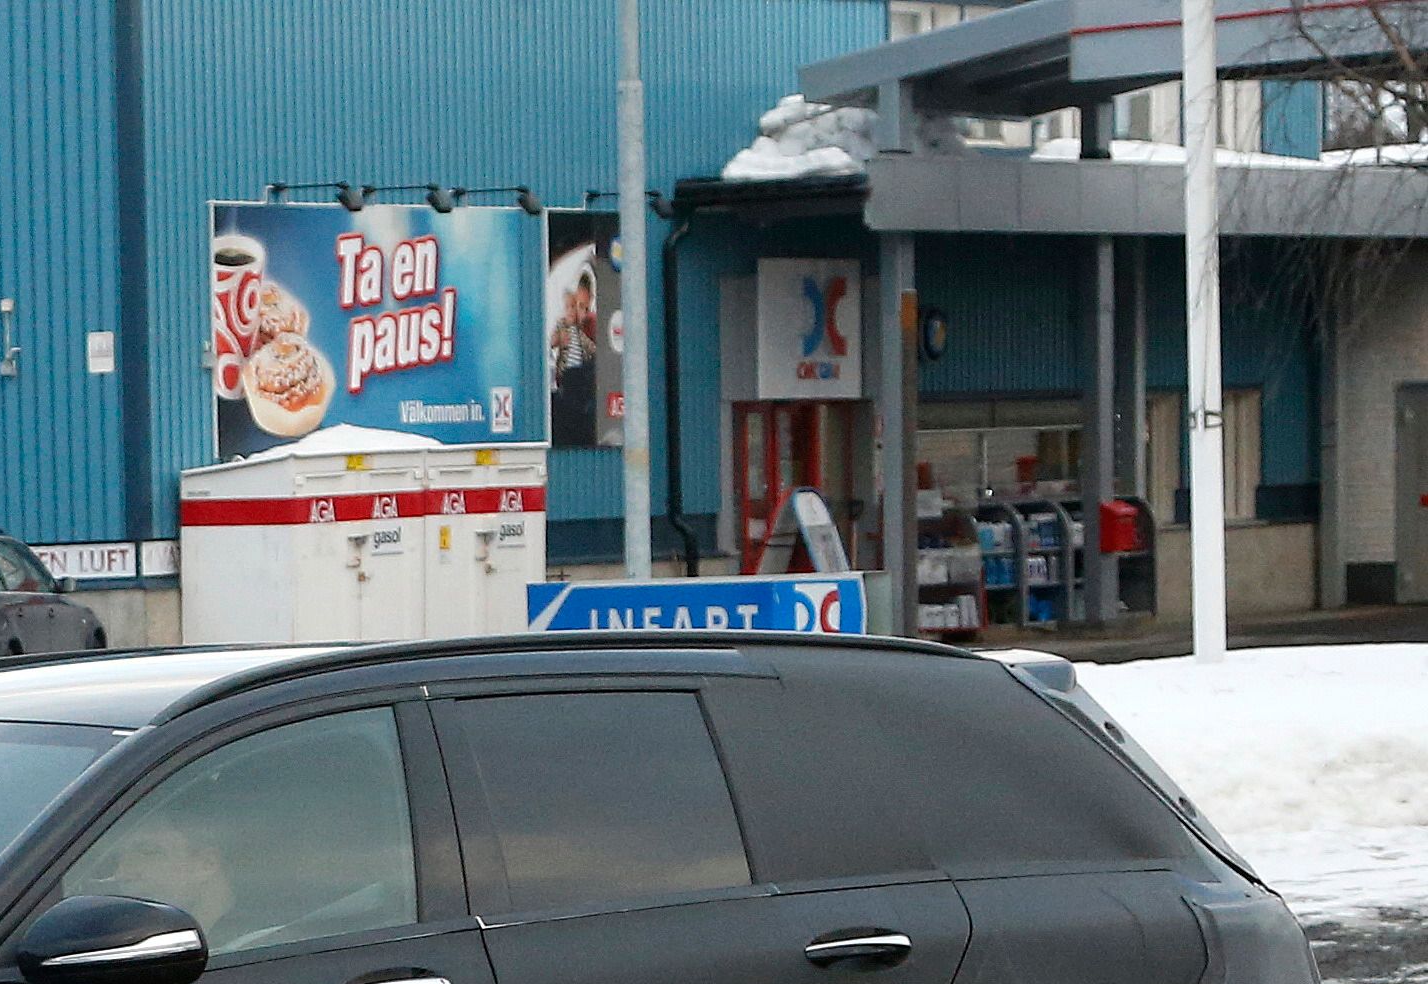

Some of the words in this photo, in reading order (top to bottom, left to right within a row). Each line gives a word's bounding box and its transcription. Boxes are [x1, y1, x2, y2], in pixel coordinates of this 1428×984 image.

[336, 233, 383, 309] Ta
[392, 235, 439, 300] en
[347, 288, 456, 394] paus!
[401, 400, 468, 423] Välkommen
[310, 498, 336, 523] AGA
[373, 494, 399, 519] AGA
[442, 490, 467, 515] AGA
[499, 489, 524, 513] AGA
[373, 528, 402, 549] gasol
[499, 521, 525, 542] gasol
[79, 549, 130, 573] LUFT
